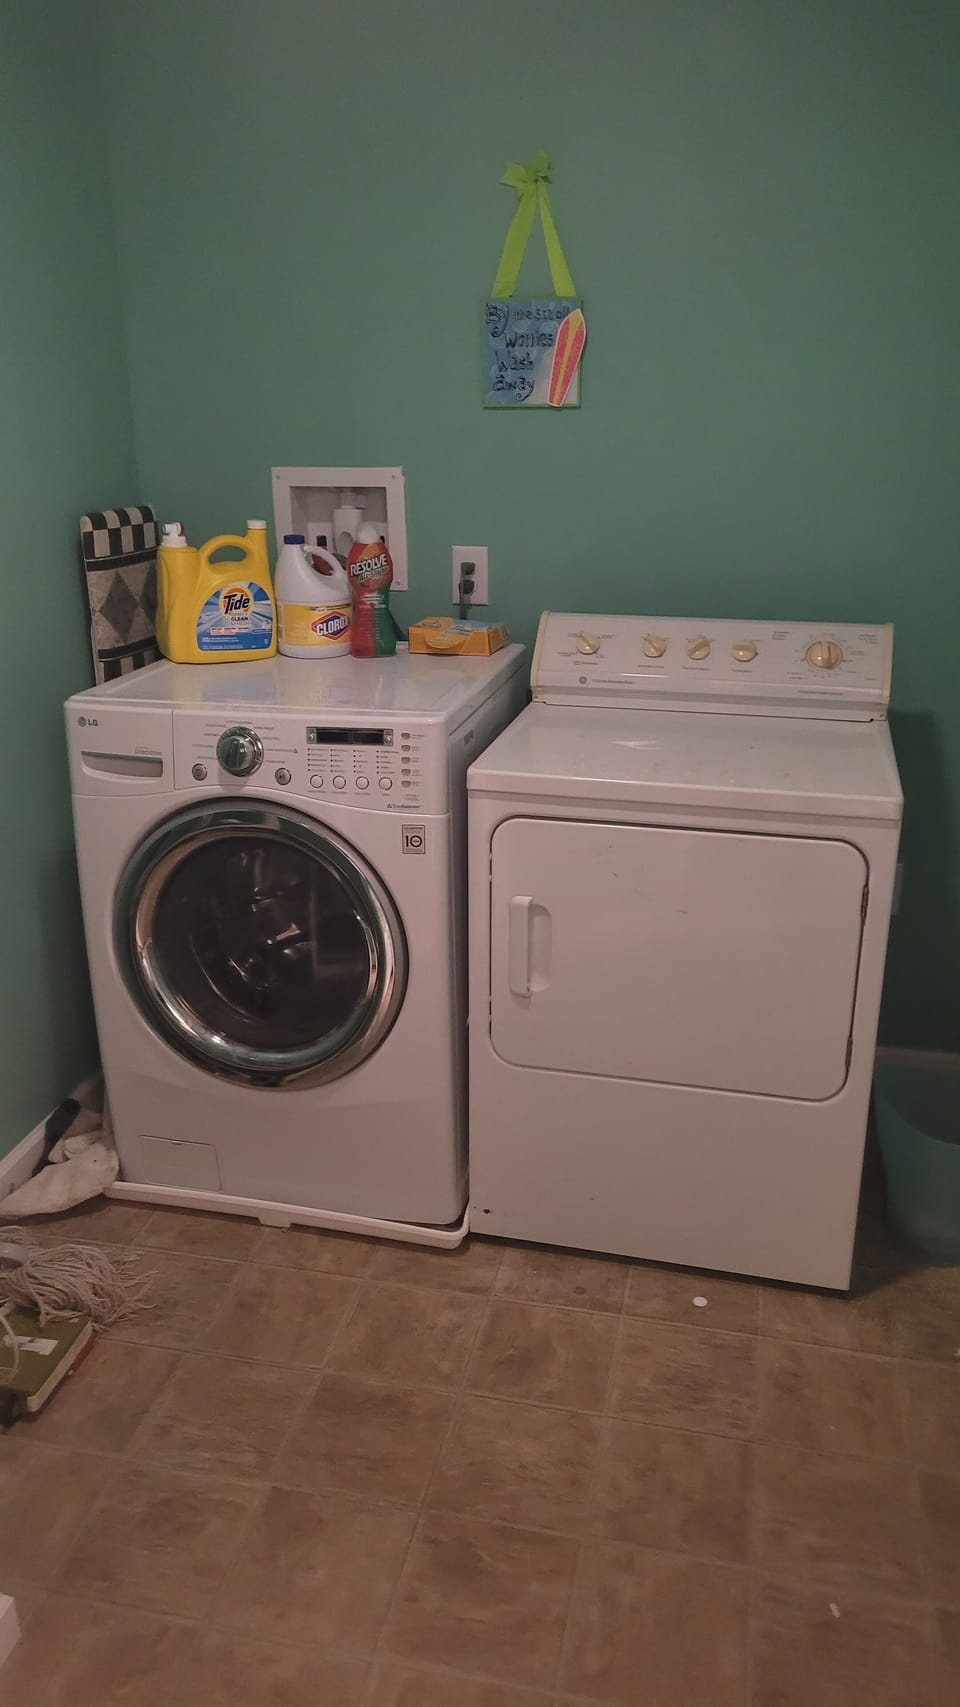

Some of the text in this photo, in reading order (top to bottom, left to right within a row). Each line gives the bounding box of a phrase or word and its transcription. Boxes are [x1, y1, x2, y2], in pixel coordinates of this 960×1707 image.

[485, 303, 509, 338] By
[495, 350, 534, 373] Wash
[350, 553, 387, 577] RESOLVE
[223, 594, 251, 615] Tide
[87, 718, 98, 727] LG
